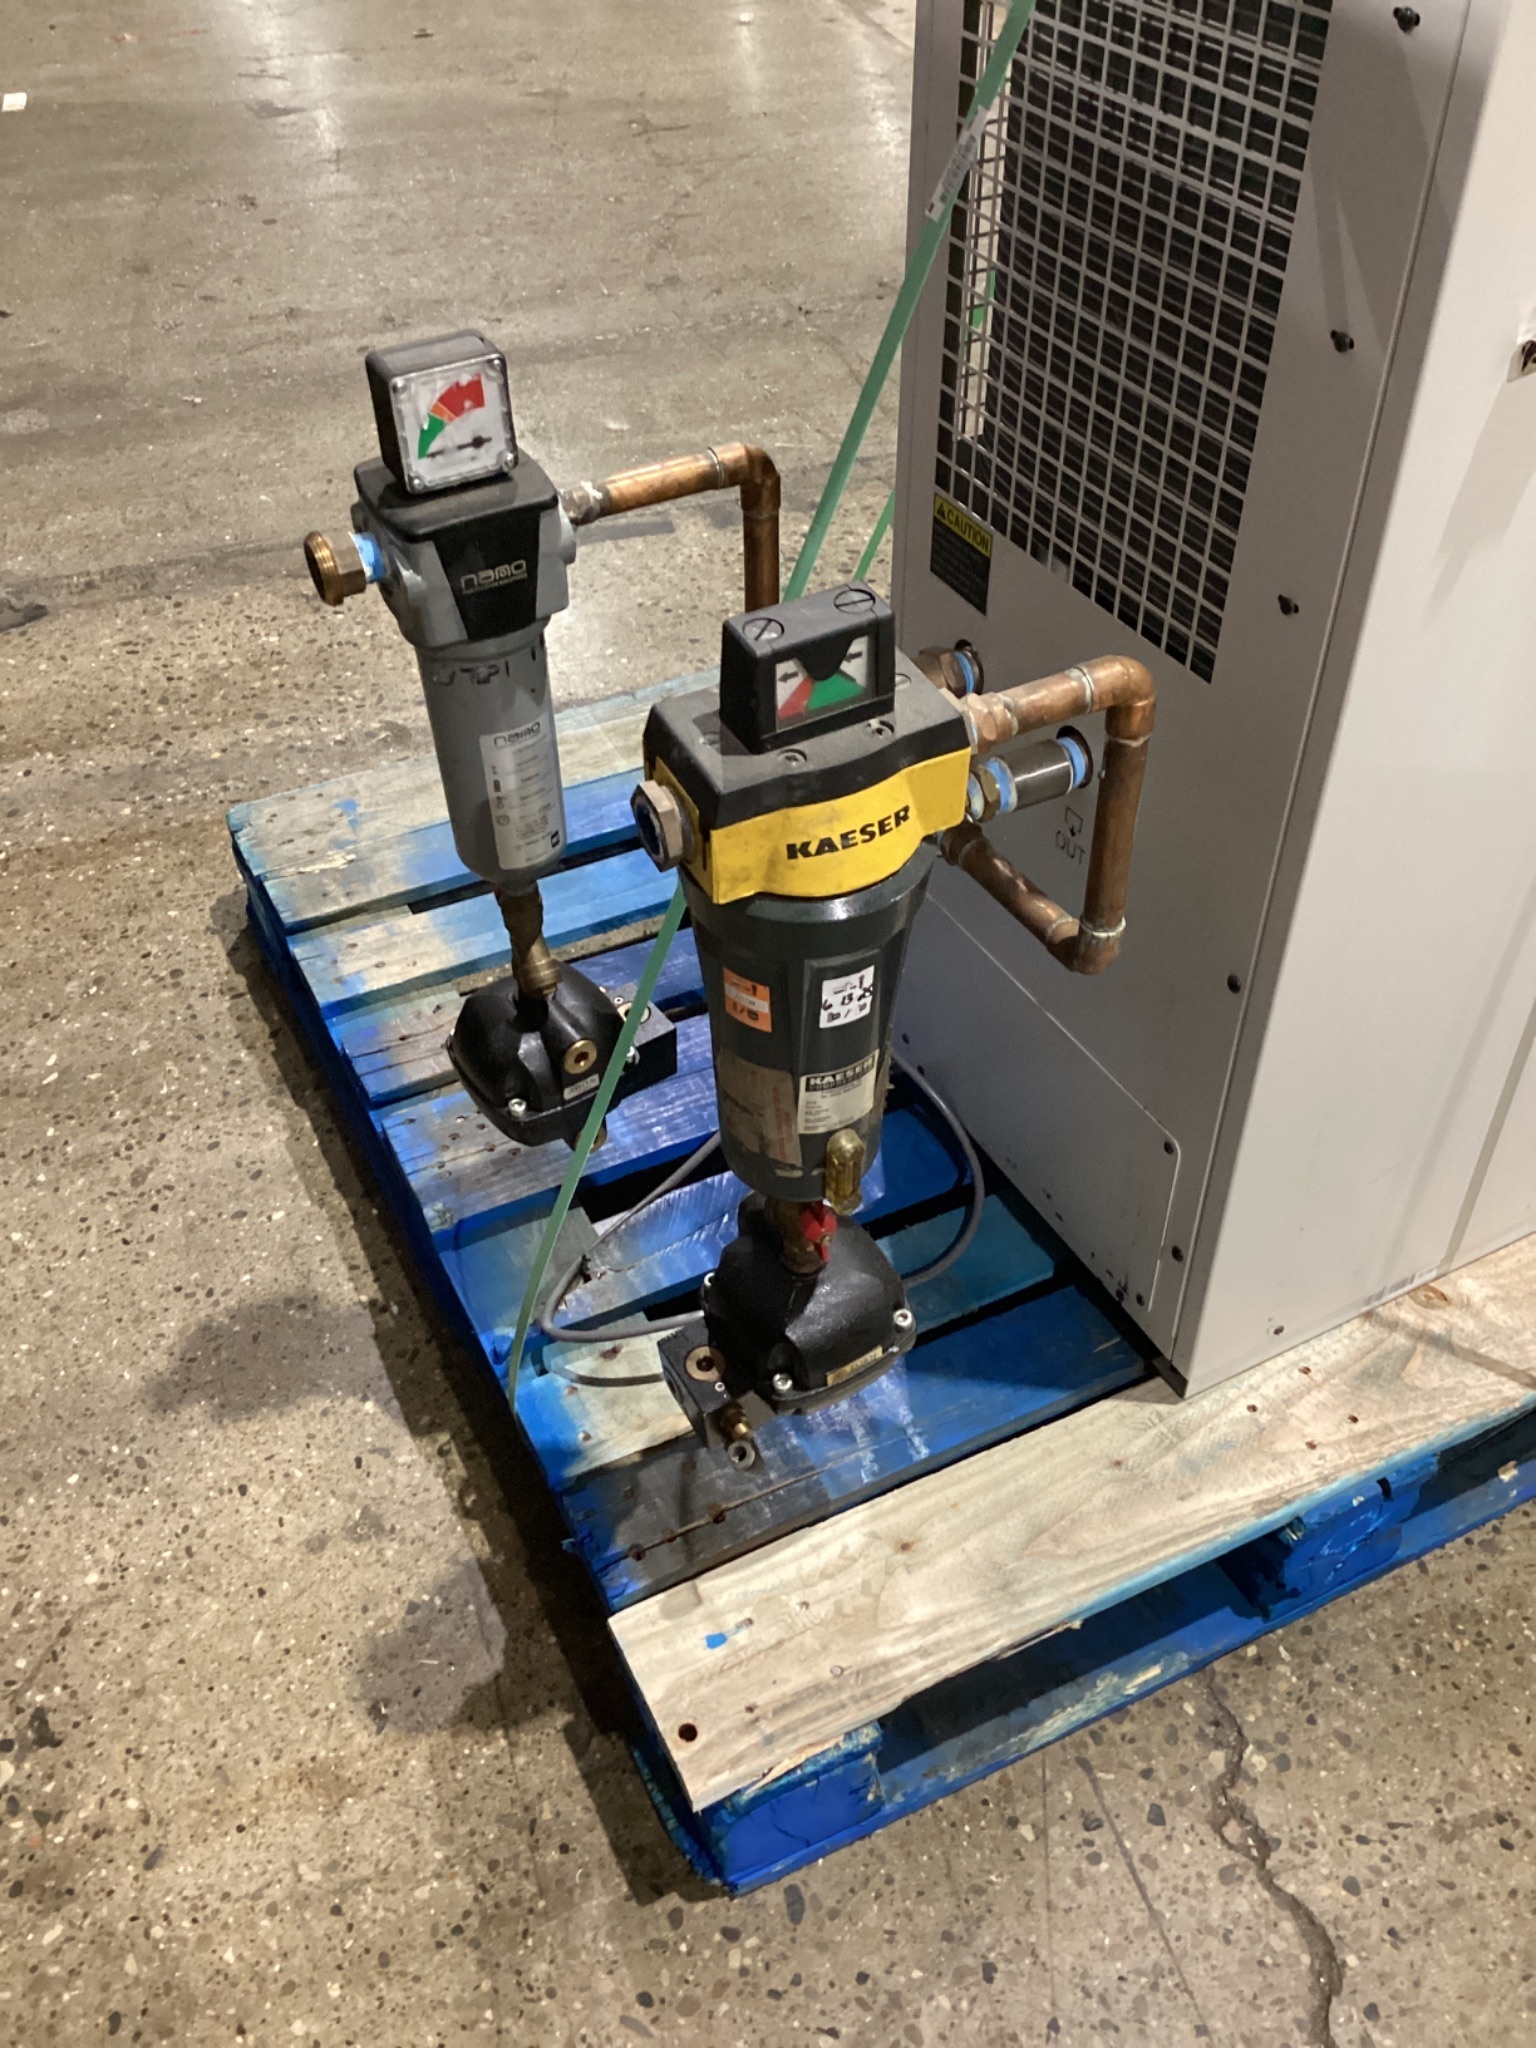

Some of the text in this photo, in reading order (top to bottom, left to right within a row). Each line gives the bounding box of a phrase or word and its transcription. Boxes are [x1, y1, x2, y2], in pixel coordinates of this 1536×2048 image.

[947, 508, 989, 553] CAUTION
[786, 804, 910, 860] KAESER
[1055, 830, 1086, 864] OUT
